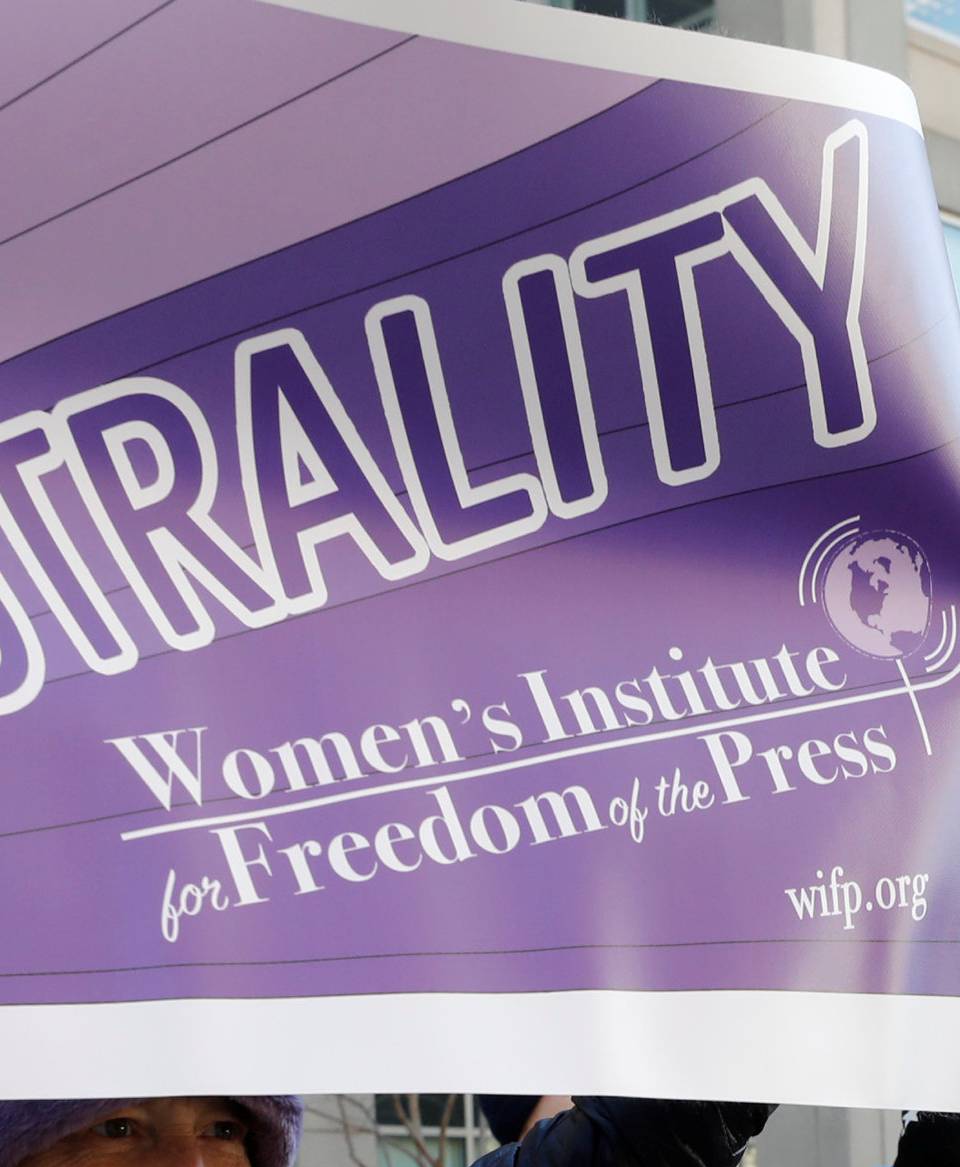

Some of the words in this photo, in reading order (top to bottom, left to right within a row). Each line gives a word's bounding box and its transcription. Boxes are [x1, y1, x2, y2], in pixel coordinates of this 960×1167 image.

[0, 118, 877, 716] TRALITY
[518, 642, 848, 743] Institute
[160, 868, 230, 942] for
[208, 784, 609, 908] Freedom
[608, 776, 648, 843] of
[655, 767, 715, 817] the
[697, 724, 897, 805] Press
[785, 866, 929, 930] wifp.org
